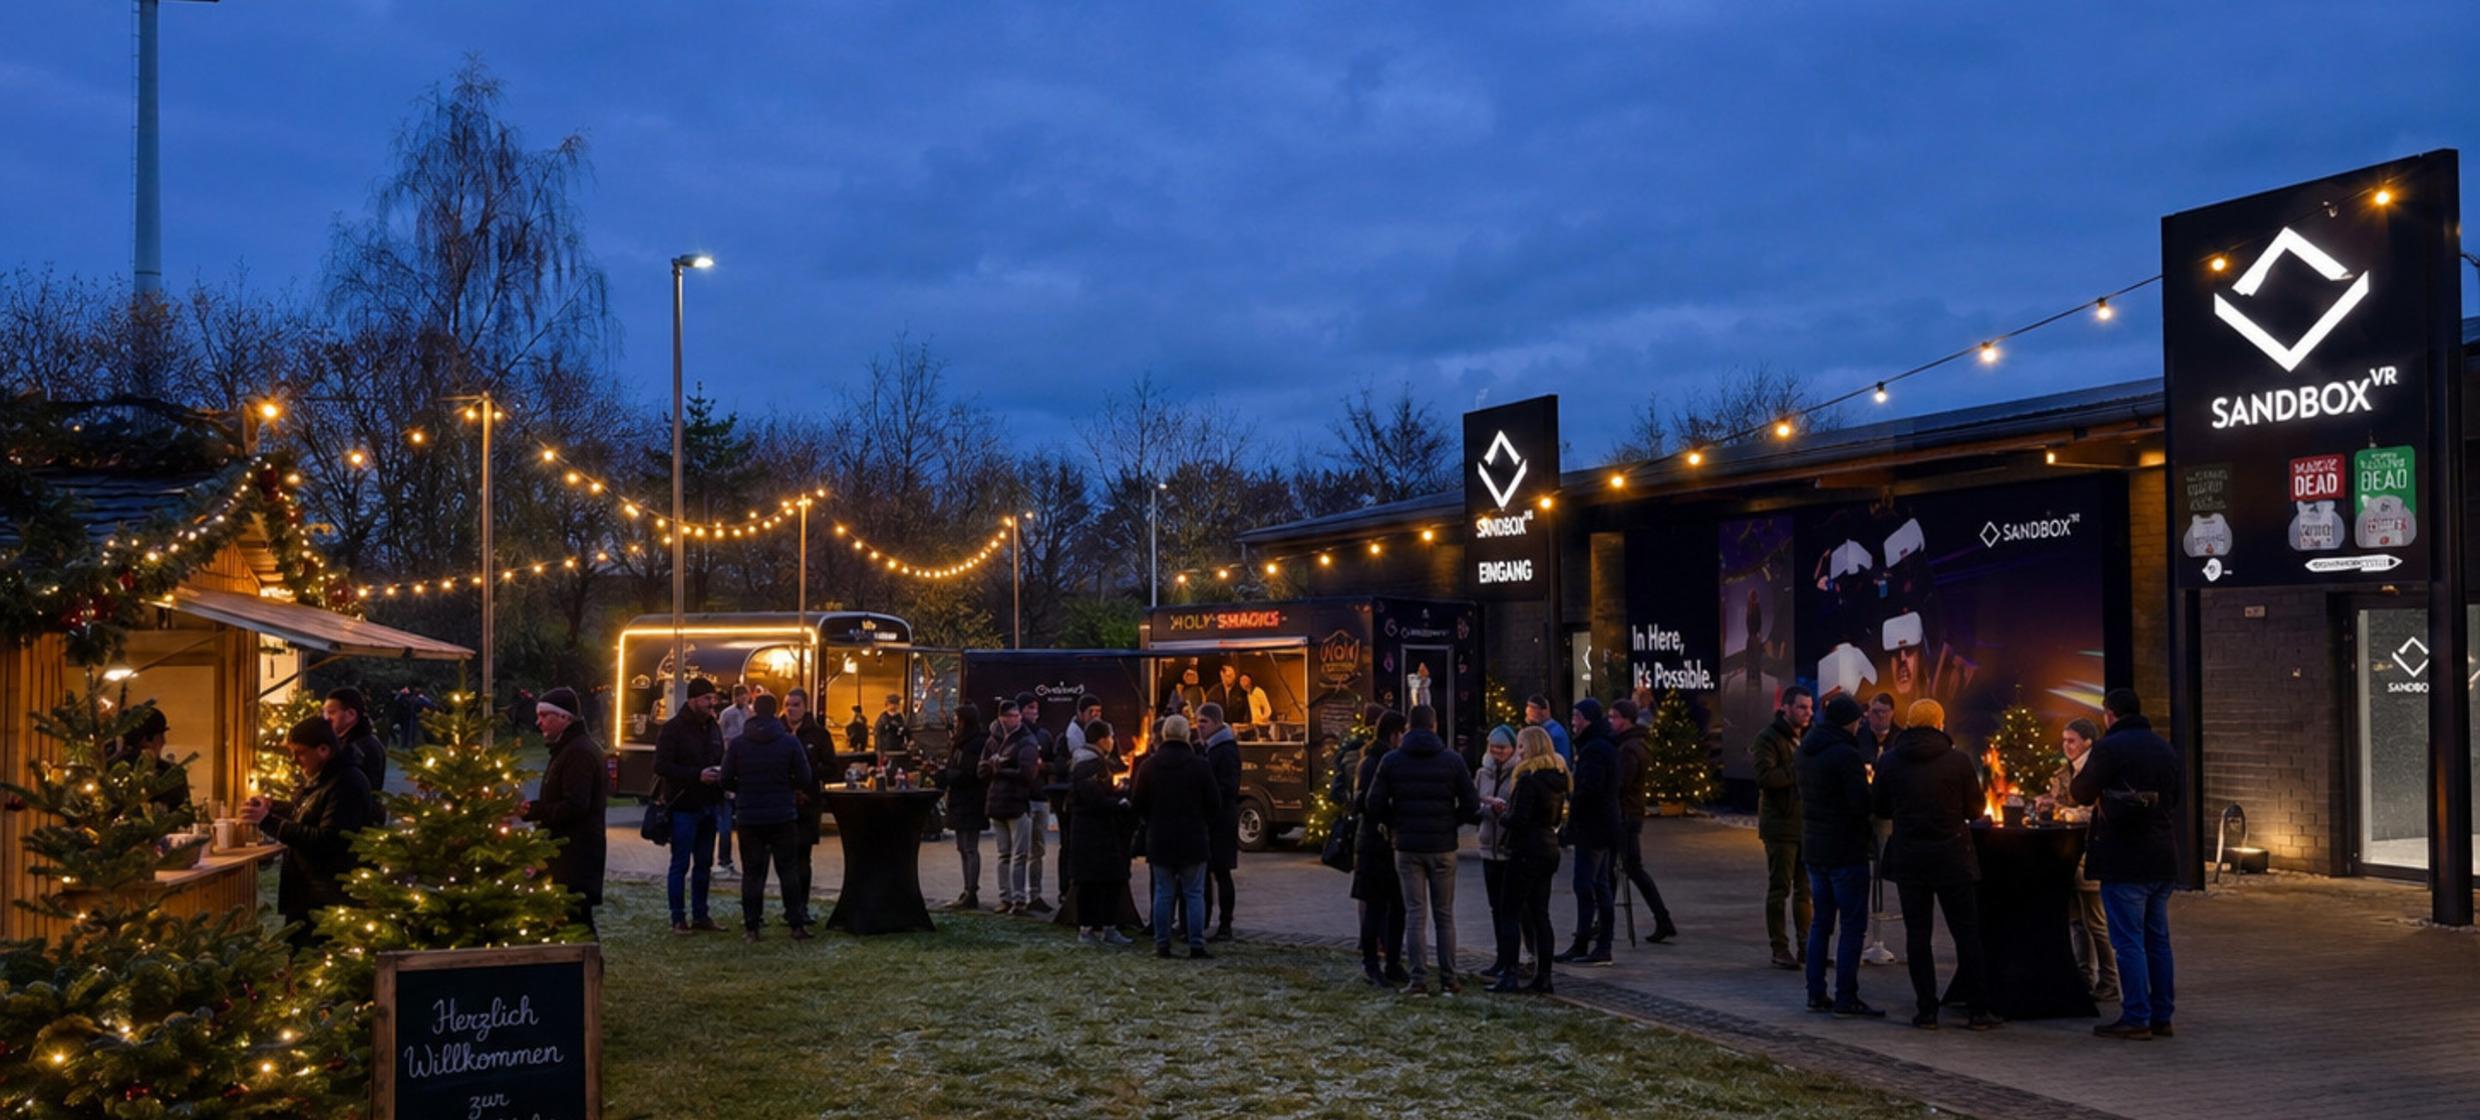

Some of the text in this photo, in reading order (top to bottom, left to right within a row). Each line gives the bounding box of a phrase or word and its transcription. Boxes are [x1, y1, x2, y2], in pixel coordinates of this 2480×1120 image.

[2294, 473, 2338, 497] DEAD
[2361, 469, 2407, 492] DEAD
[1478, 559, 1532, 584] EINGANG
[1632, 624, 1685, 656] In Here,
[1633, 660, 1715, 690] It's Possible.
[2388, 682, 2429, 693] SANDBO
[432, 995, 539, 1042] Herzlich
[404, 1042, 564, 1078] Willkommen
[468, 1093, 509, 1120] zur
